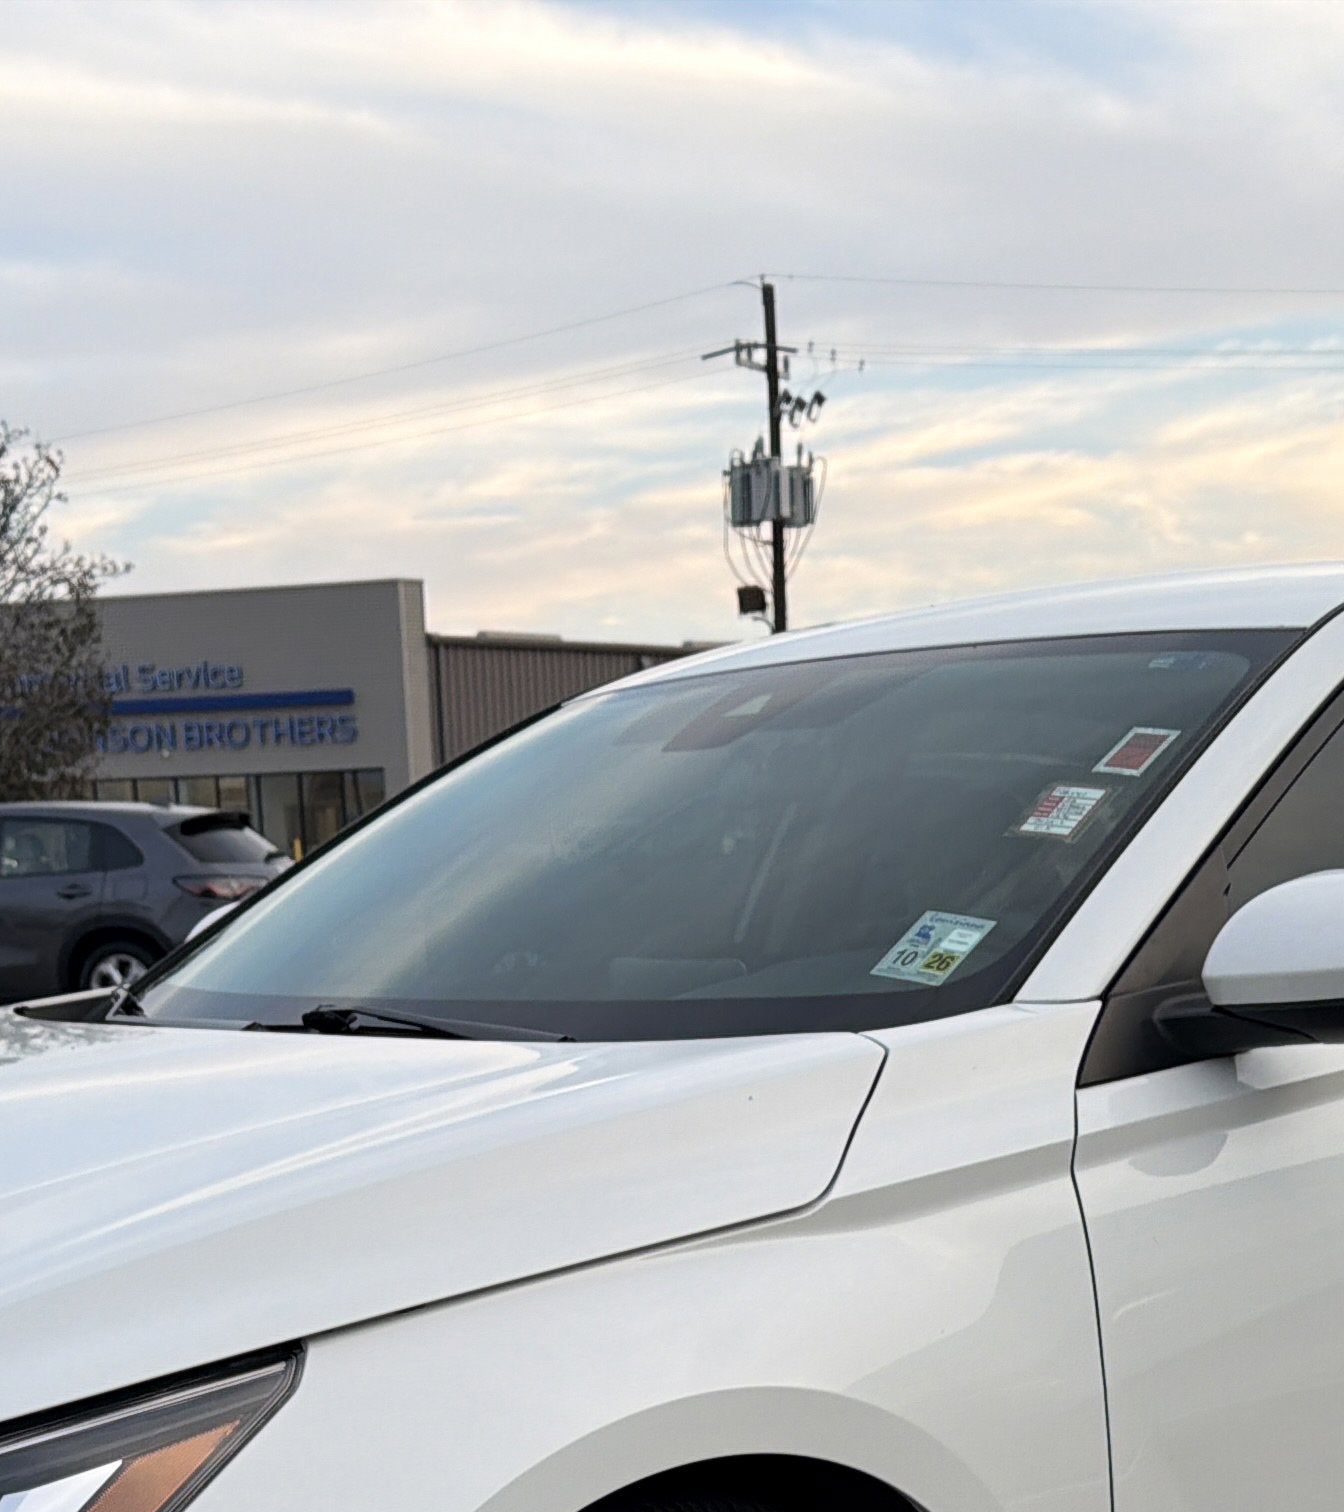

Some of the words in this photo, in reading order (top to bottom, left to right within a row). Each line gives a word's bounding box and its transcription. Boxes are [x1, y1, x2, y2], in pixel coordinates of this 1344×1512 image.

[137, 660, 243, 692] Service
[182, 714, 359, 750] BROTHERS
[892, 948, 918, 967] 10
[923, 952, 958, 972] 26
